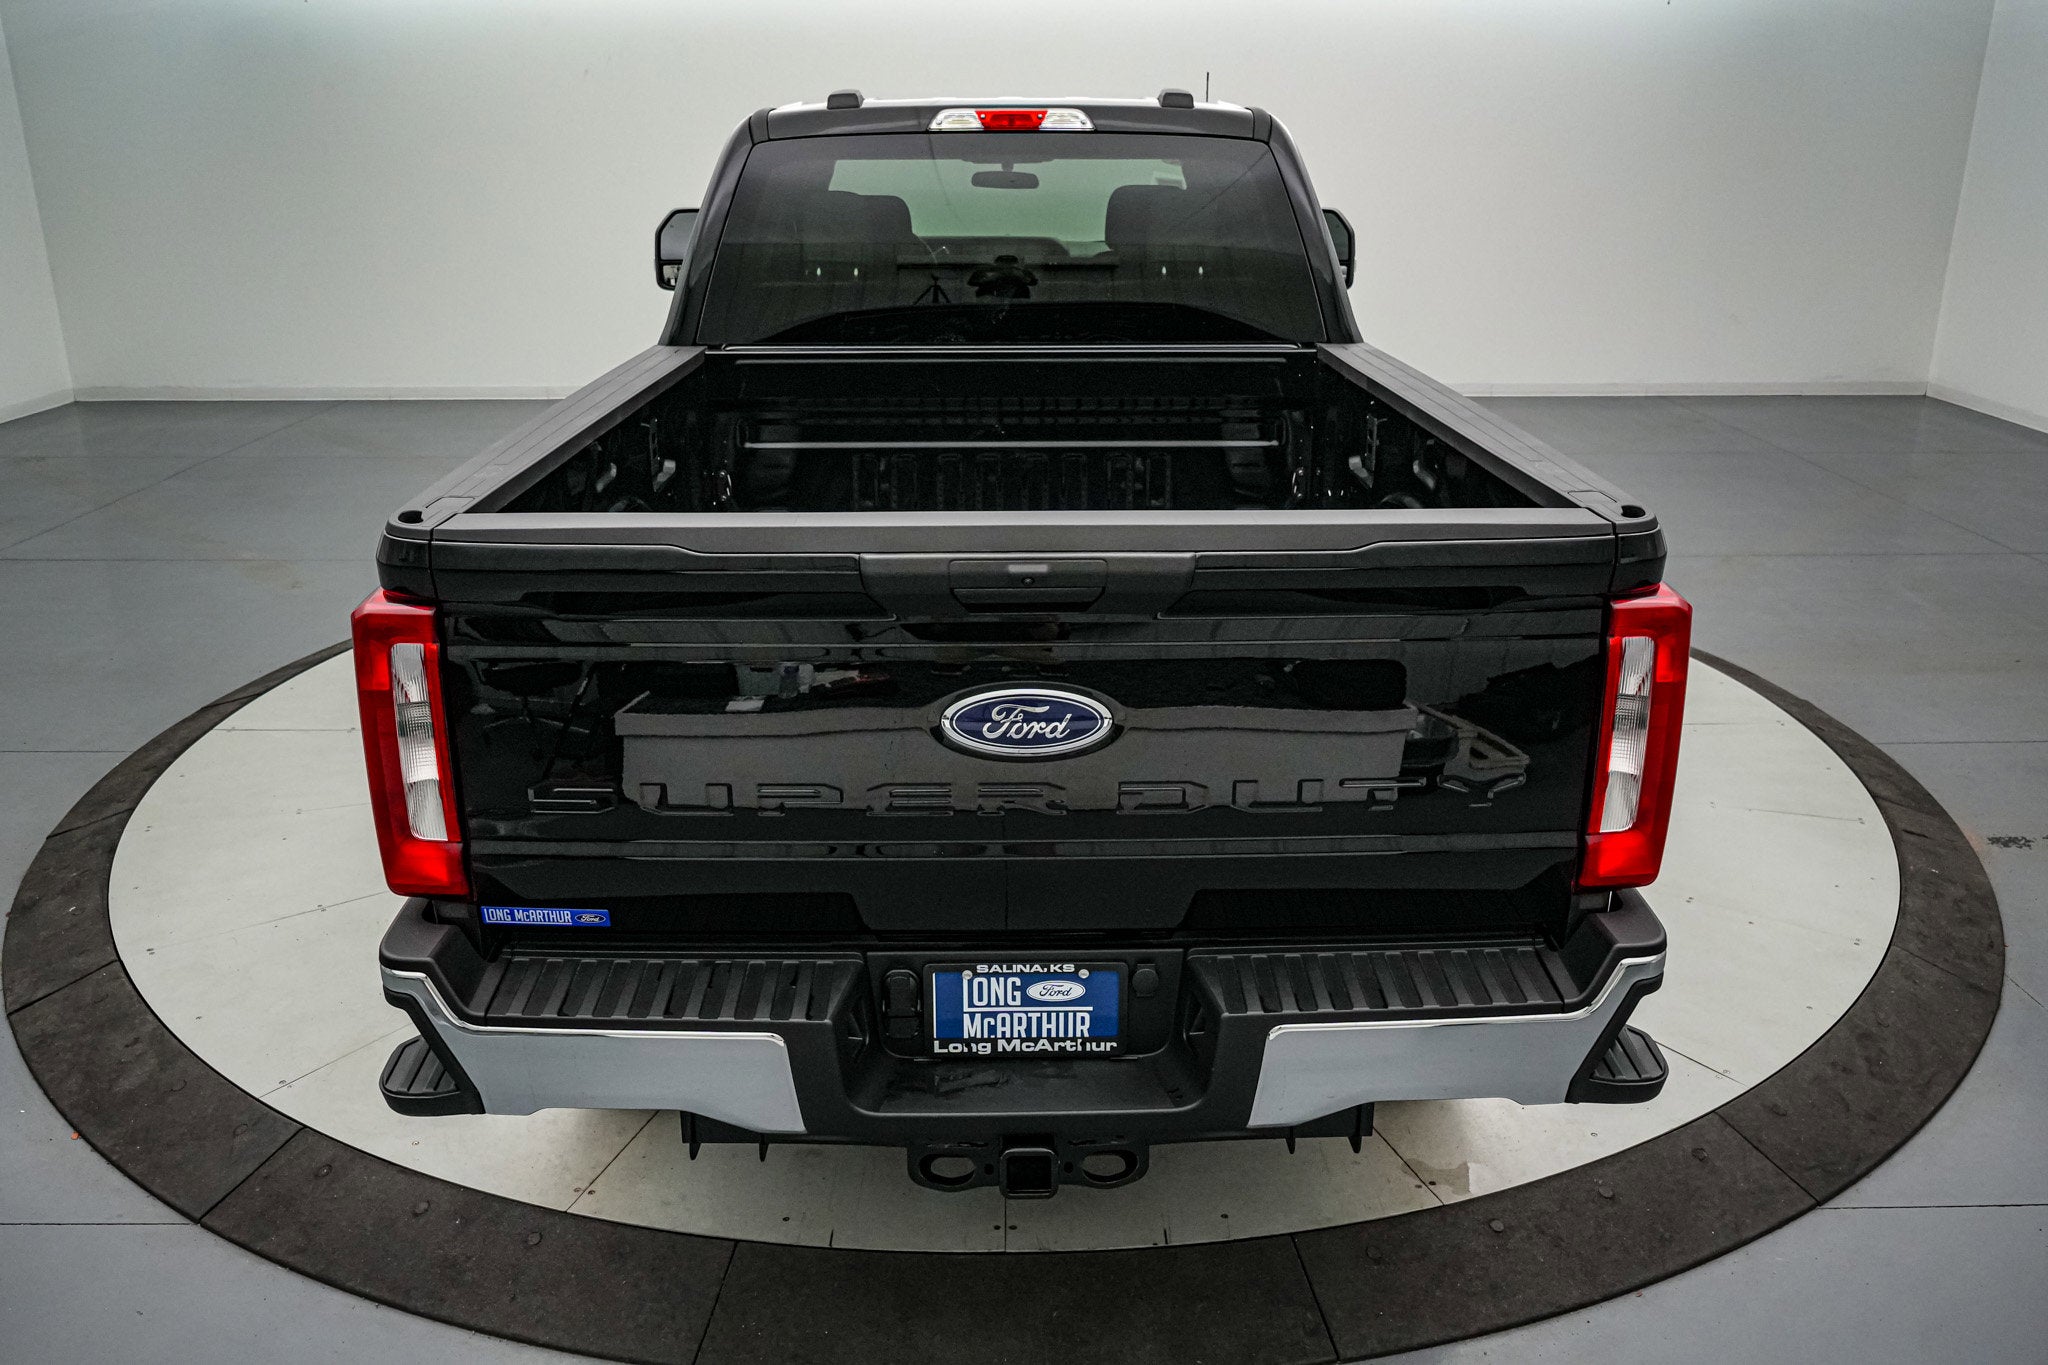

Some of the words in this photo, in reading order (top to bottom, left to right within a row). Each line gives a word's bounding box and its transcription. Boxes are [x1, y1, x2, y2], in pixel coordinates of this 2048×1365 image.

[983, 703, 1072, 739] Ford
[527, 782, 1067, 816] SUPER
[1116, 777, 1526, 815] DUTY
[484, 908, 511, 923] LONG
[514, 909, 572, 923] McARTHUR
[976, 964, 1048, 973] SALINA,
[1050, 964, 1076, 973] KS
[963, 977, 1021, 1011] LONG
[1039, 984, 1073, 998] Ford
[963, 1012, 1091, 1039] McARTHUR
[933, 1040, 992, 1055] Long
[997, 1039, 1118, 1053] McArthur
